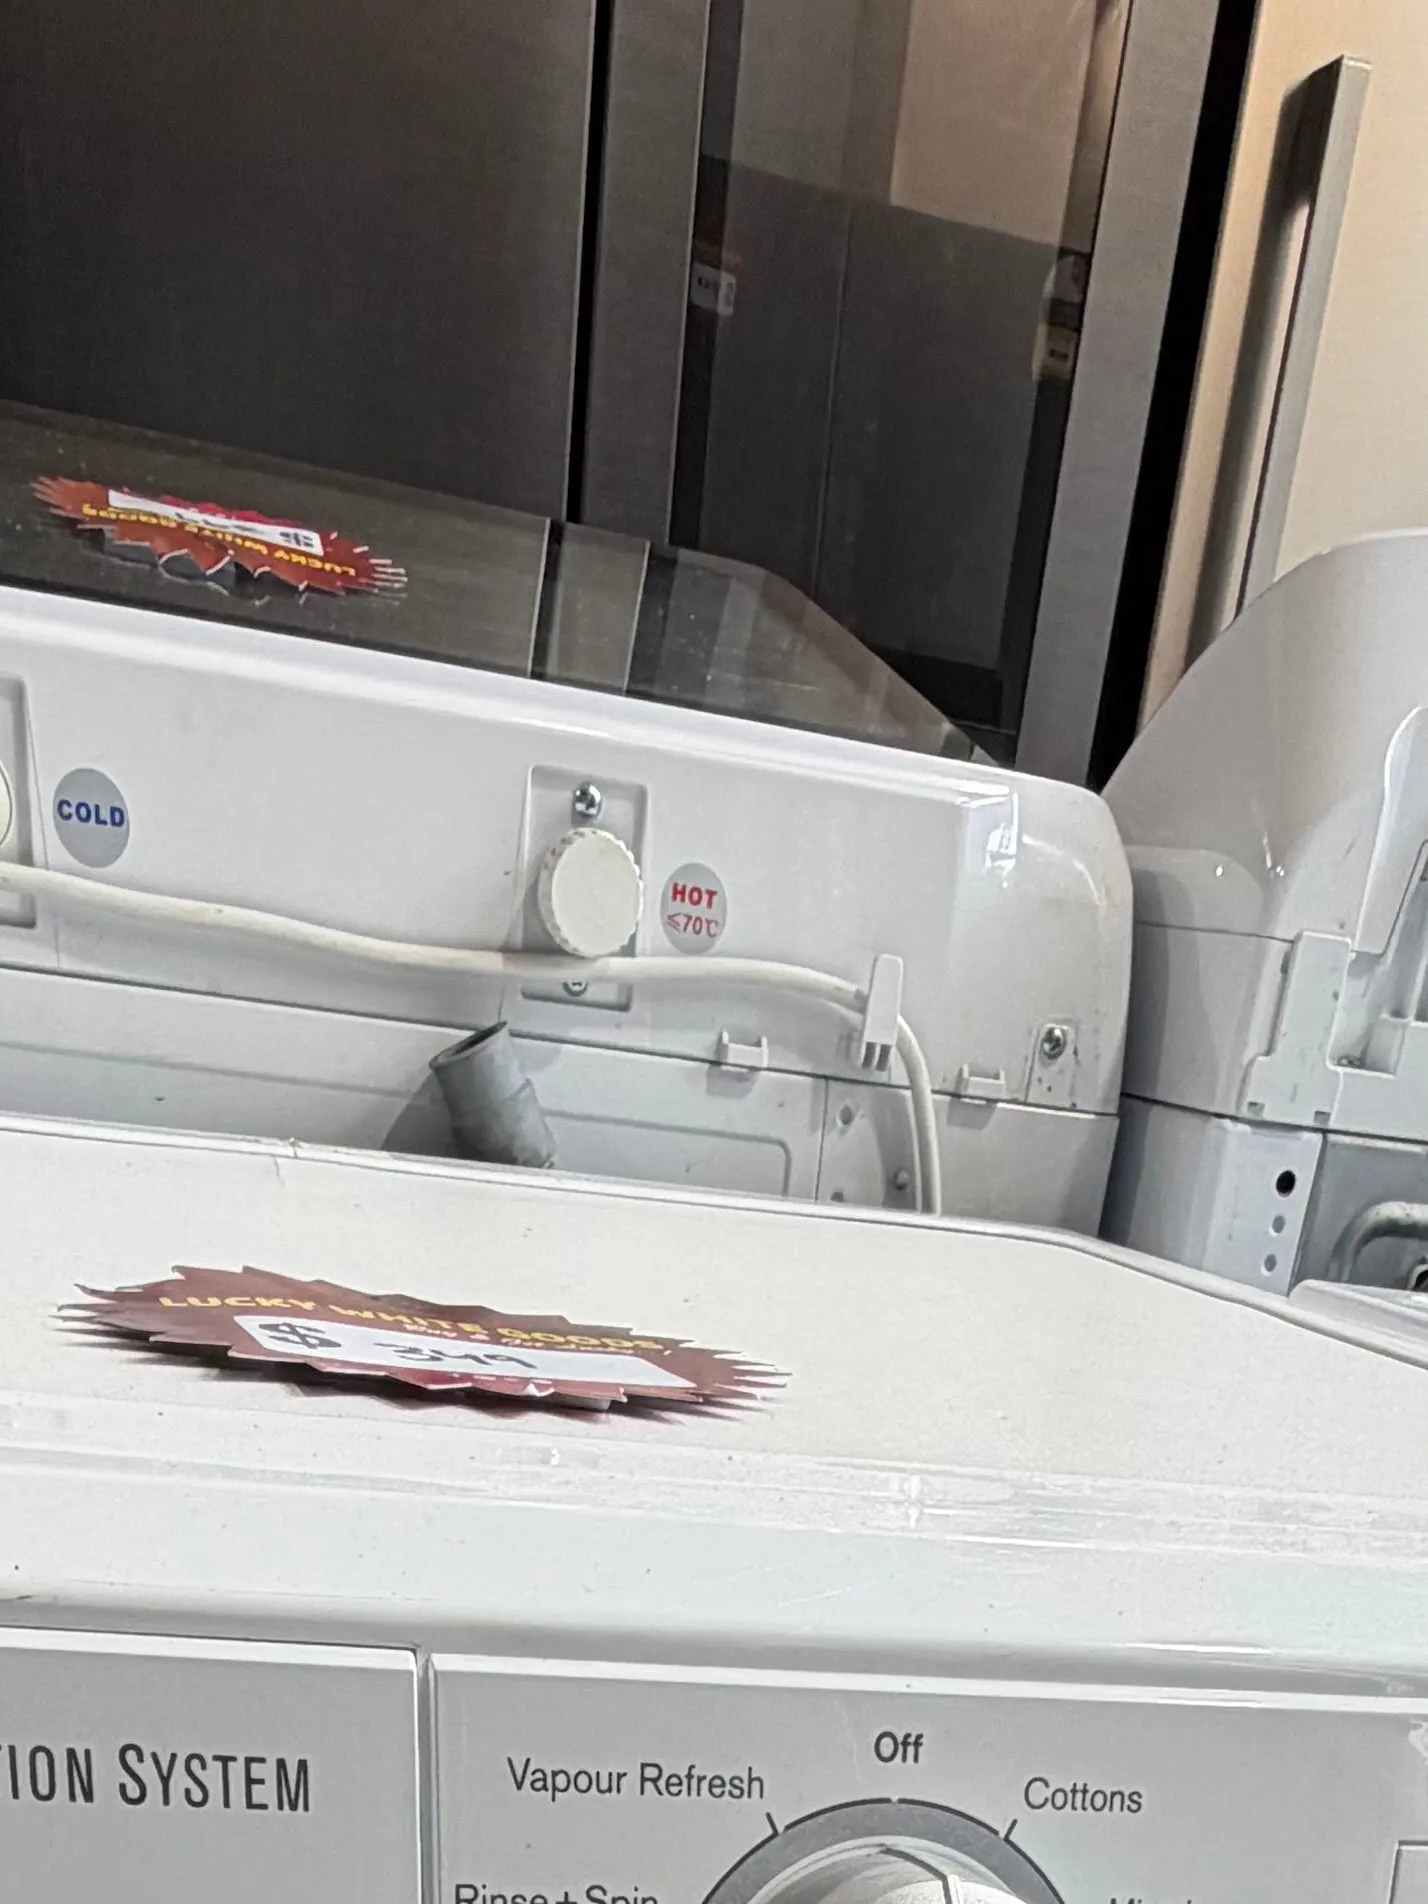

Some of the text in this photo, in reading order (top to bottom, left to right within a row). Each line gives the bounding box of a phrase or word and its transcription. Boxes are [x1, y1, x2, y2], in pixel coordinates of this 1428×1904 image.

[55, 799, 126, 829] COLD
[672, 882, 717, 909] HOT
[158, 1296, 317, 1311] LUCKY
[328, 1306, 486, 1334] WHITE
[874, 1731, 924, 1764] Off
[117, 1743, 311, 1812] SYSTEM
[507, 1756, 764, 1802] Vapour Refresh
[1024, 1777, 1144, 1814] Cottons
